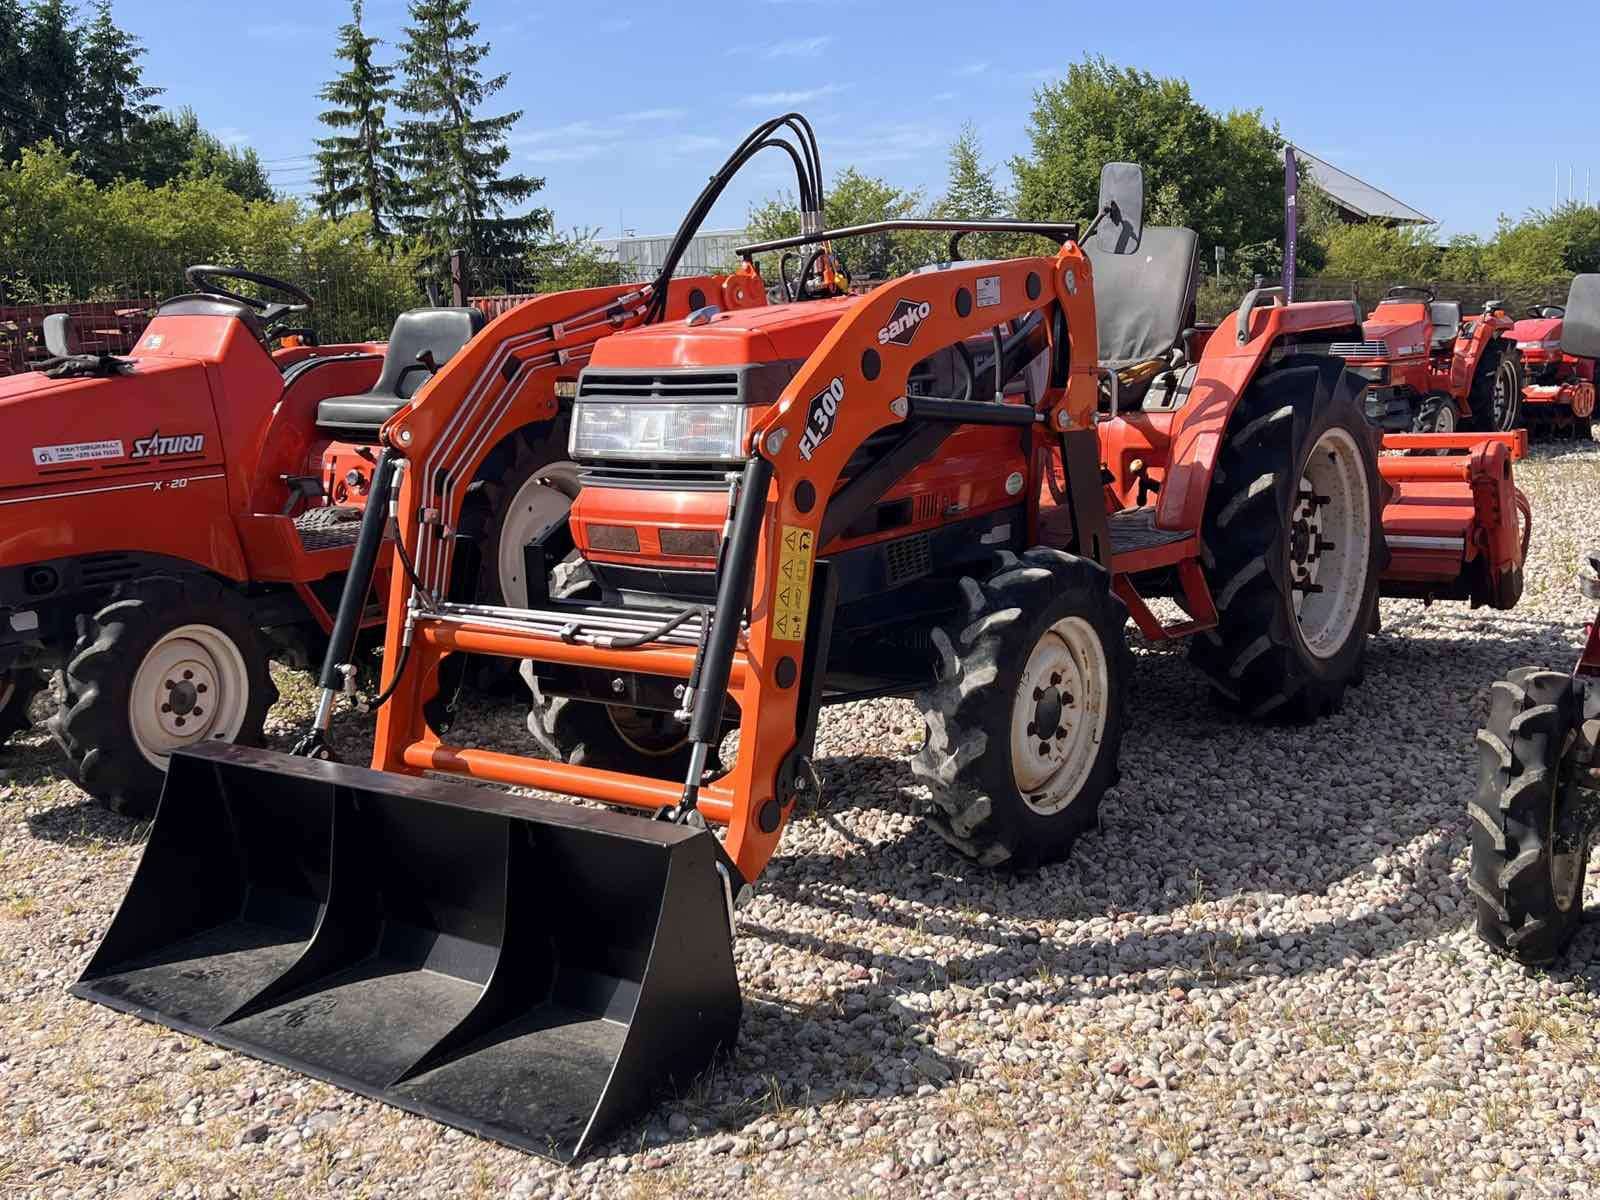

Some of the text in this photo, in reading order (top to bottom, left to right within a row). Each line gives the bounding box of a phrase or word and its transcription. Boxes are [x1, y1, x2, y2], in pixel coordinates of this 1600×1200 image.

[877, 301, 931, 345] sanko
[798, 376, 845, 462] FL300
[131, 432, 204, 458] SATURN
